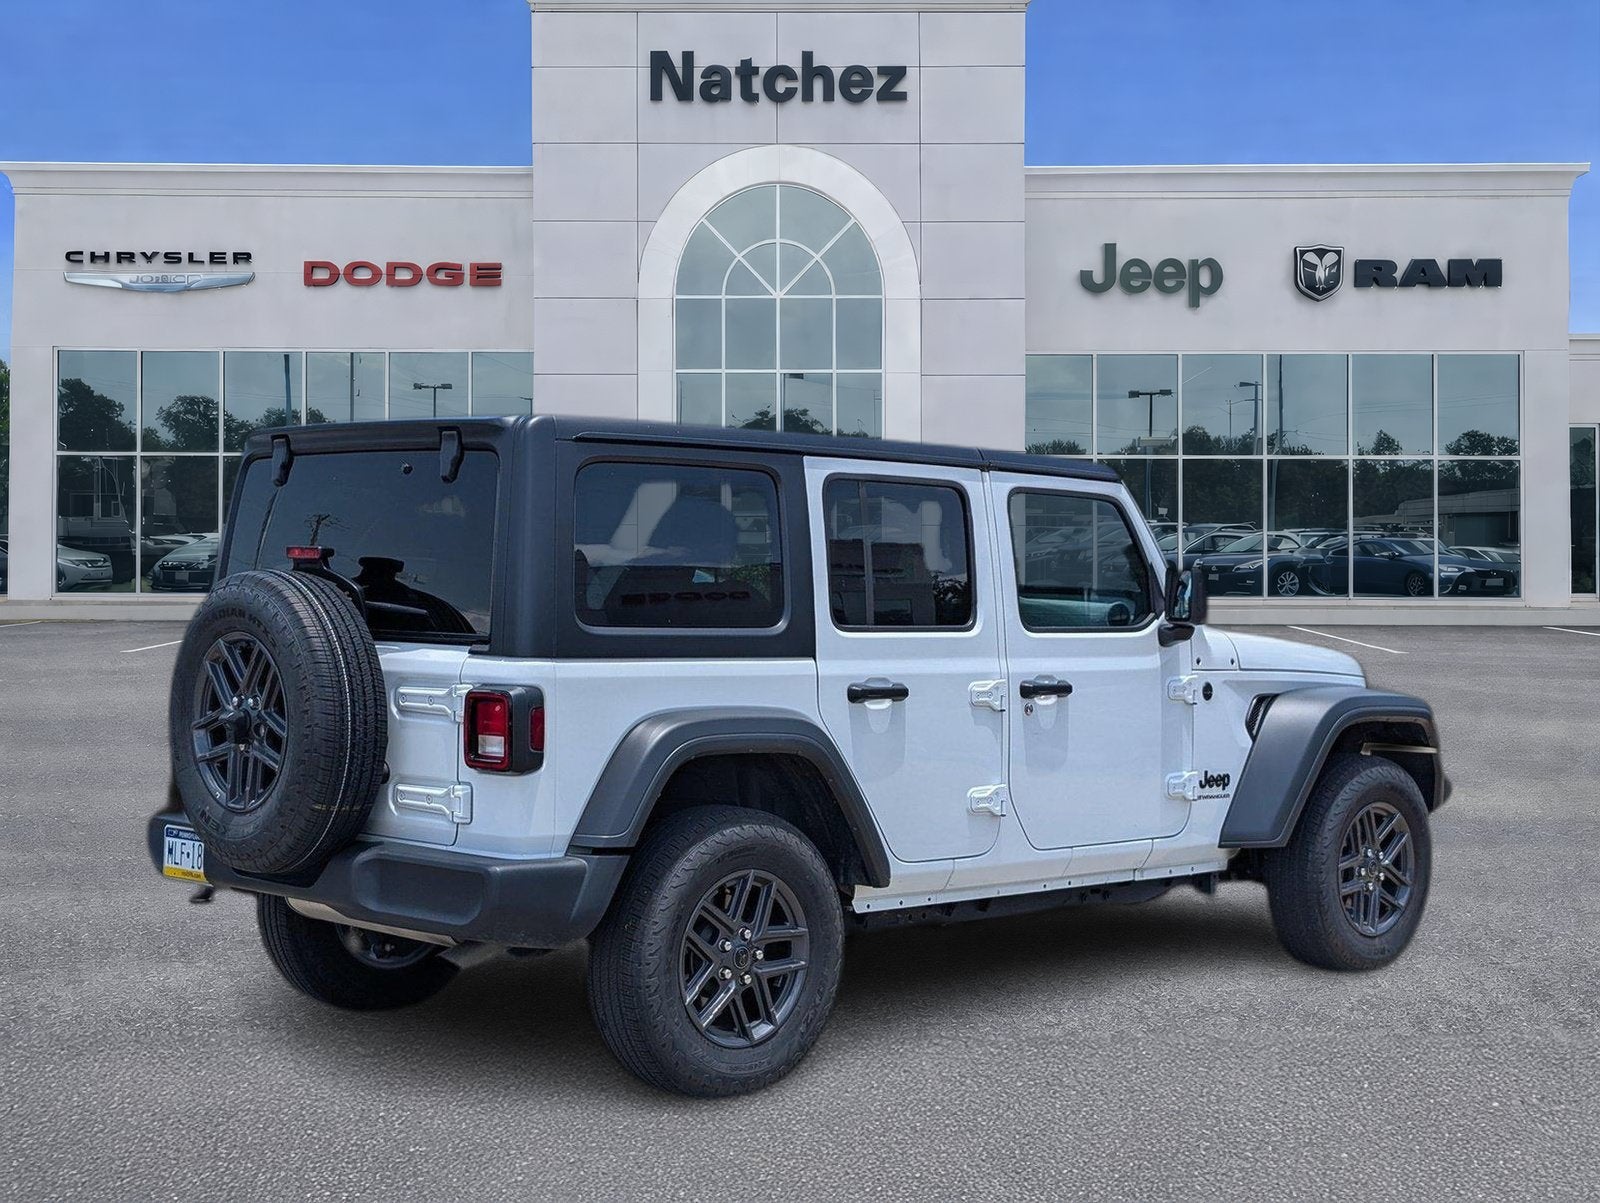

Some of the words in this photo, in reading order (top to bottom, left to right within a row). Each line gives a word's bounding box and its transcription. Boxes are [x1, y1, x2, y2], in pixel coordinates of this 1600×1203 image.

[650, 50, 908, 103] Natchez
[65, 250, 253, 265] CHRYSLER
[303, 260, 503, 288] DODGE
[1079, 242, 1224, 309] Jeep
[1354, 258, 1503, 289] RAM
[1199, 770, 1230, 790] Jeep
